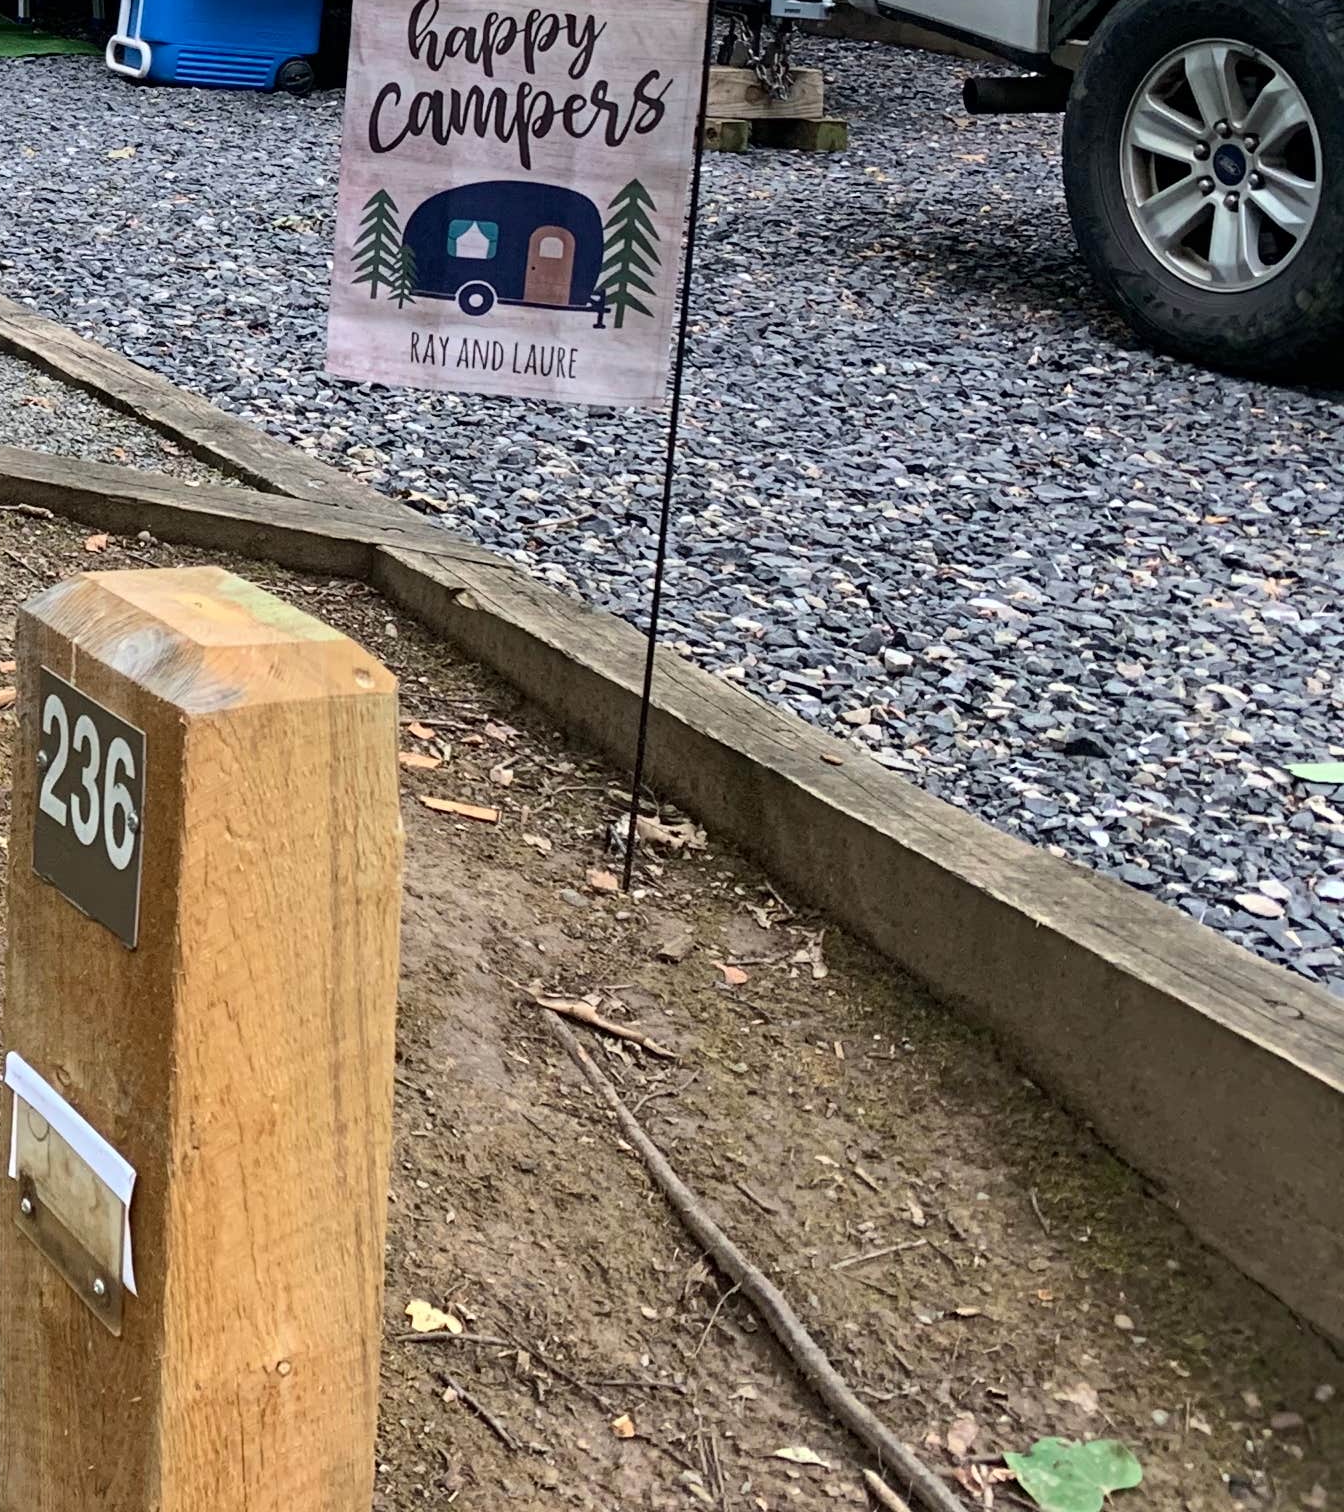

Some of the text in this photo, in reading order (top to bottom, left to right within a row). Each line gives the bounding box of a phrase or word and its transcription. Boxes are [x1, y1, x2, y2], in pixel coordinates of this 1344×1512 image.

[410, 331, 579, 379] RAY AND LAURE
[39, 693, 137, 871] 236
